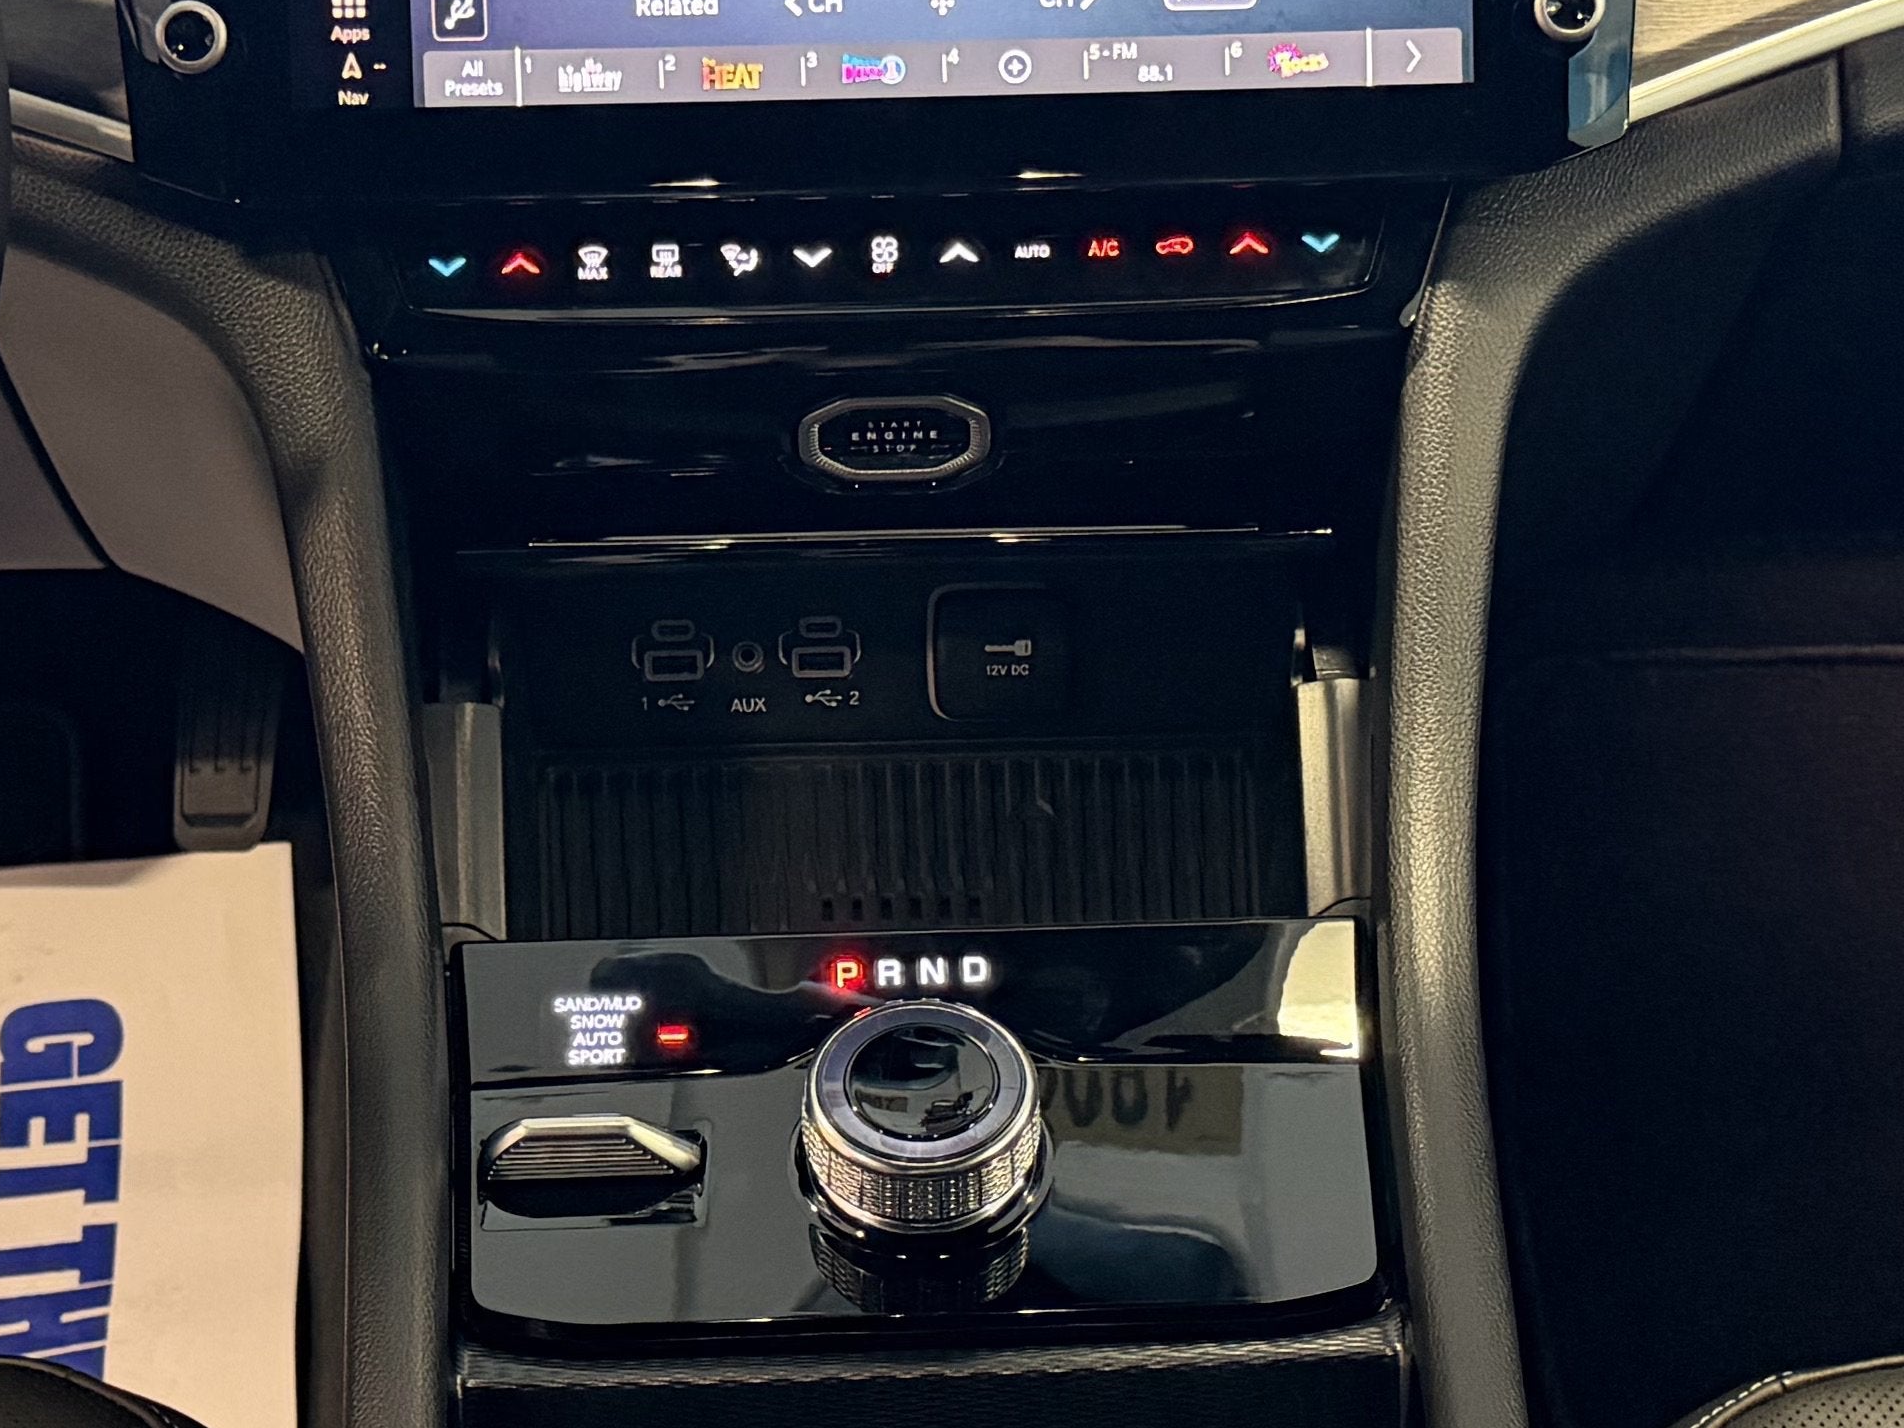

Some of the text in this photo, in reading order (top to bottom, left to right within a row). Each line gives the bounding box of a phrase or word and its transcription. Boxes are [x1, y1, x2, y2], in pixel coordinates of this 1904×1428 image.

[330, 25, 371, 44] Apps
[947, 47, 960, 64] 4
[1231, 41, 1243, 58] 6
[461, 59, 484, 77] All
[664, 54, 677, 71] 2
[805, 51, 818, 68] 3
[702, 62, 764, 91] HEAT
[1138, 62, 1174, 83] 88.1
[444, 78, 504, 97] Presets
[338, 90, 369, 107] Nav
[1014, 244, 1051, 259] AUTO
[1087, 238, 1120, 258] A/C
[577, 266, 609, 280] MAX
[867, 420, 922, 429] START
[851, 429, 938, 442] ENGINE
[872, 444, 918, 453] STOP
[985, 664, 1030, 677] 12V DC
[641, 696, 649, 711] 1
[730, 696, 767, 713] AUX
[848, 691, 860, 706] 2
[835, 955, 989, 989] P R N D
[553, 995, 643, 1013] SAND/MUD
[569, 1013, 626, 1030] SNOW
[572, 1031, 624, 1047] AUTO
[567, 1048, 627, 1066] SPORT
